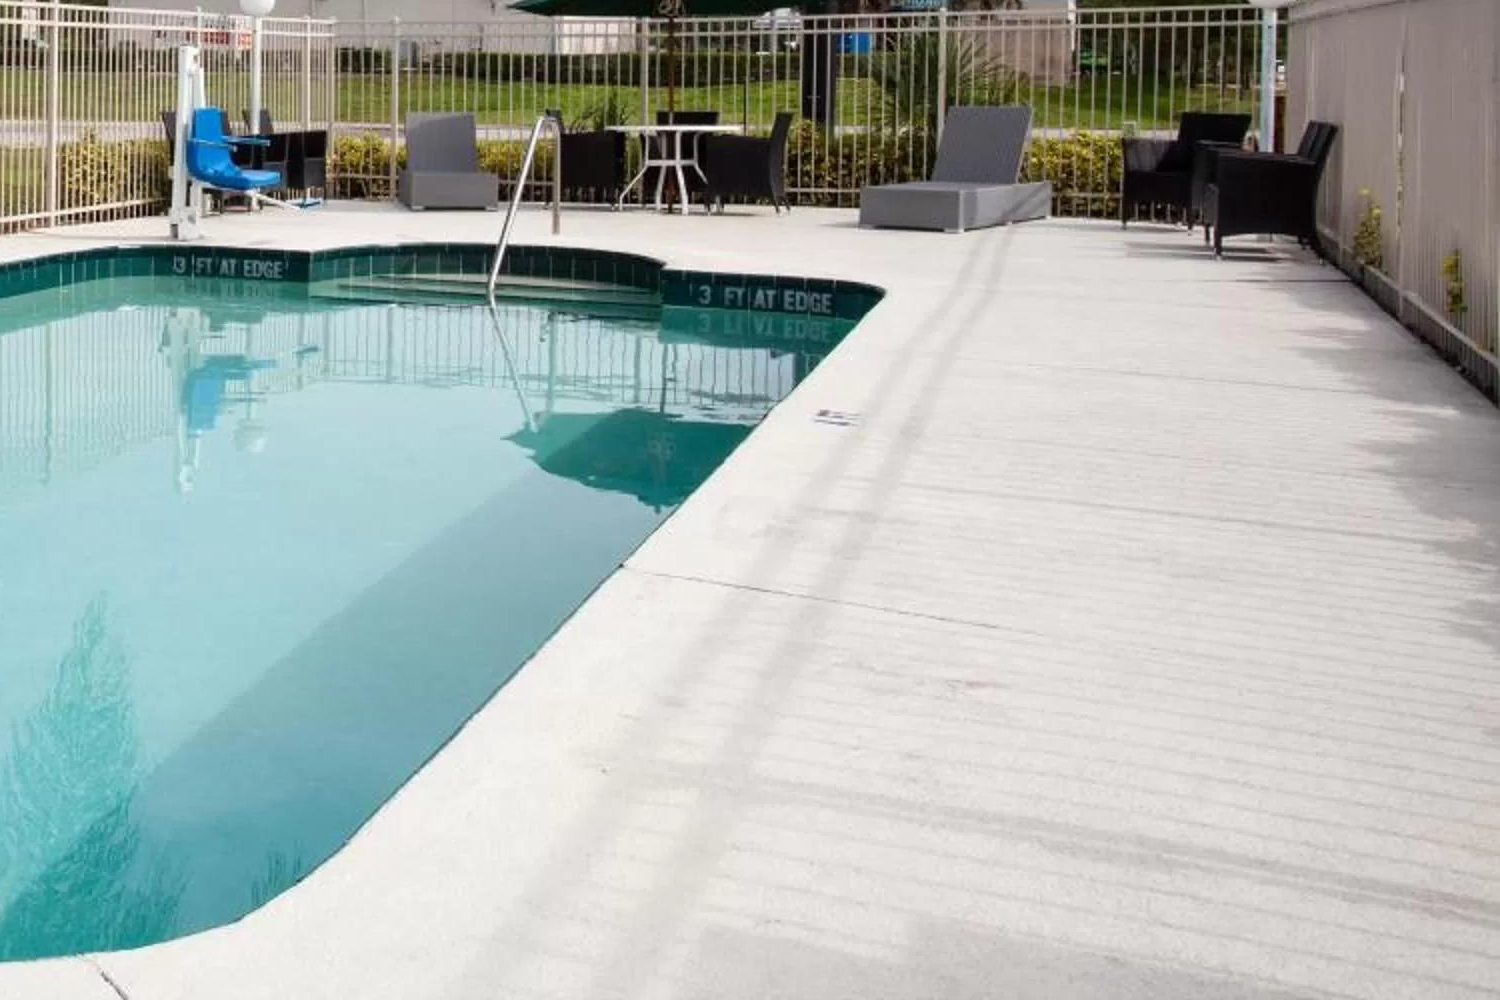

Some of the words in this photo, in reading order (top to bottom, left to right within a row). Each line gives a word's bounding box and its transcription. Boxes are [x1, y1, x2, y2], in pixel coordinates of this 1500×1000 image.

[195, 258, 213, 274] FT
[220, 258, 237, 276] AT
[243, 260, 283, 279] EDGE
[699, 284, 711, 305] 3
[723, 287, 745, 307] FT
[753, 289, 777, 309] AT
[783, 289, 833, 314] EDGE
